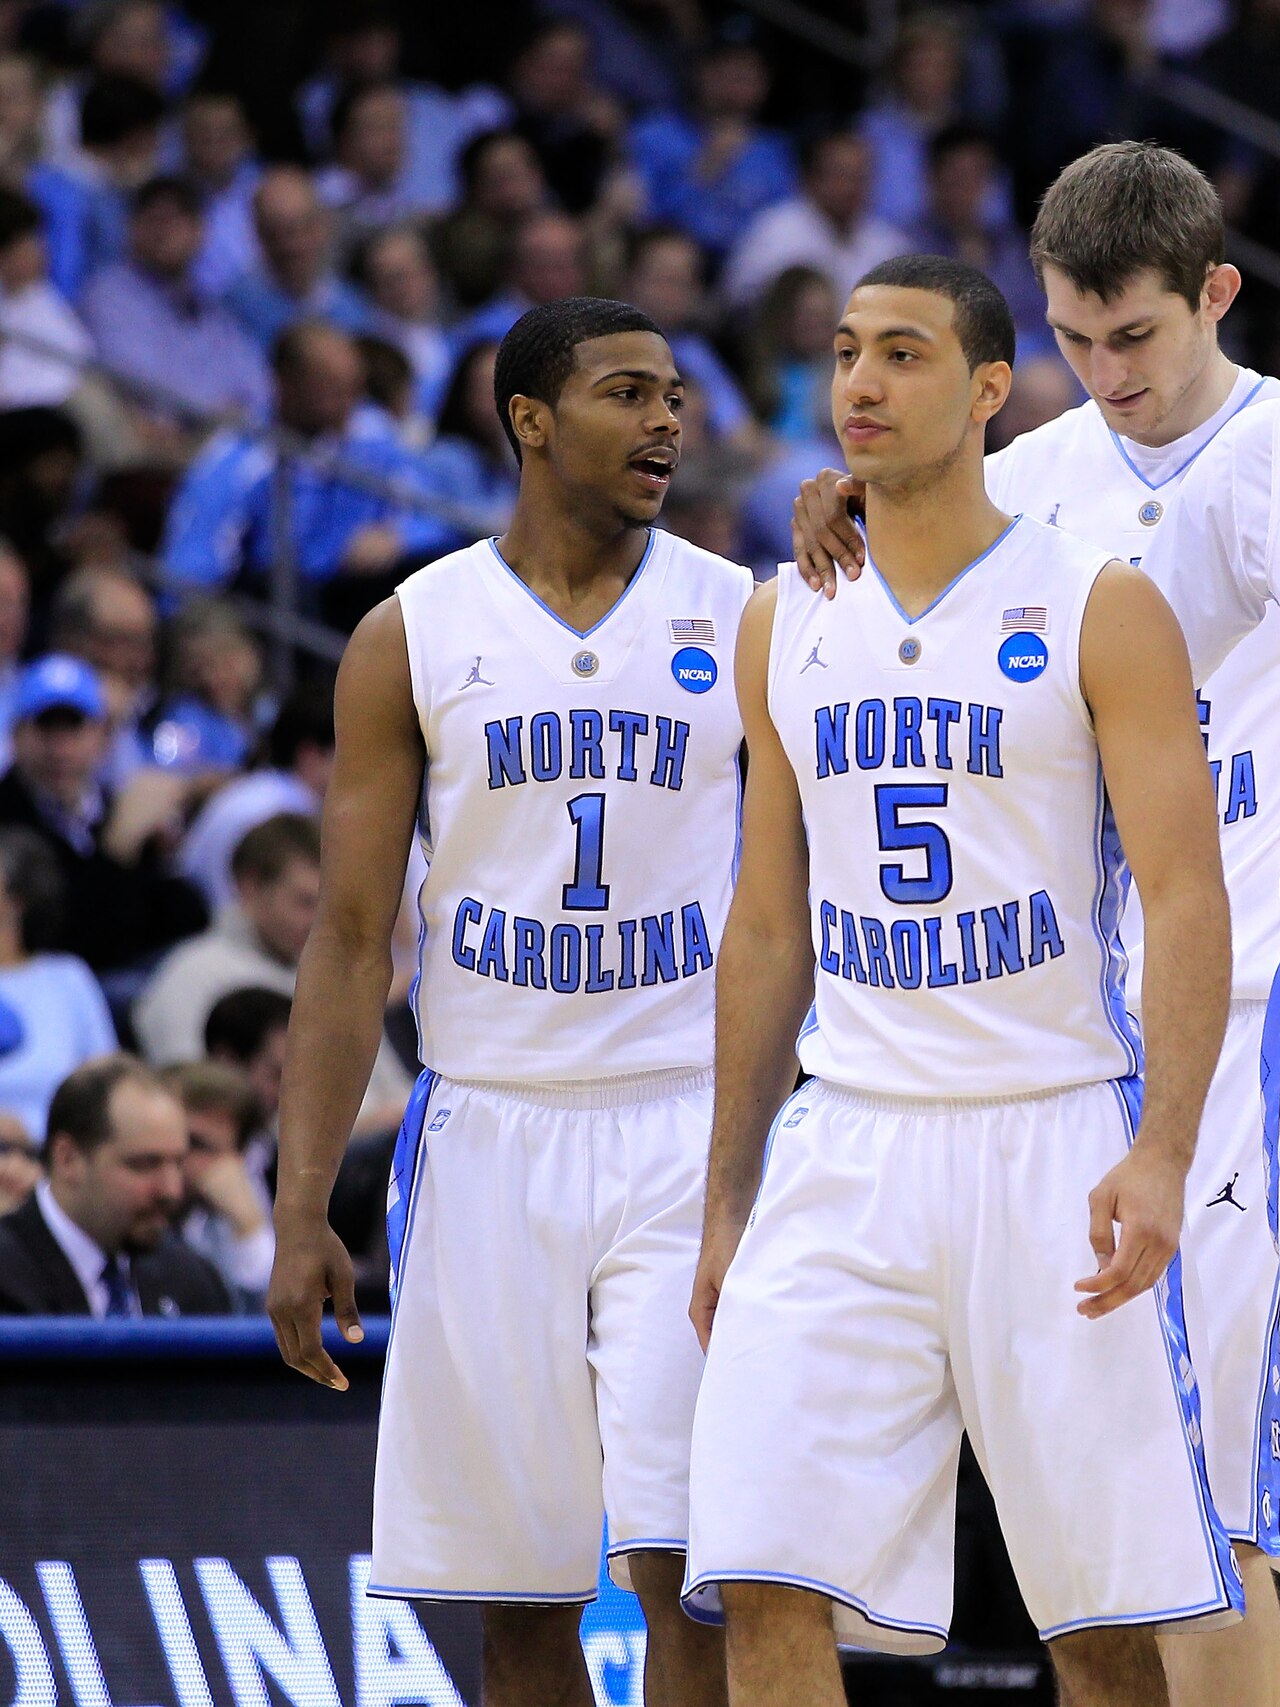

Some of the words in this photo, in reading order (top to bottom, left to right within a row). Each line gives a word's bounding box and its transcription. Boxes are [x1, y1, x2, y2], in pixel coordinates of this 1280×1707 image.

[678, 668, 712, 682] NCAA
[1008, 655, 1045, 669] NCAA
[484, 709, 690, 790] NORTH
[814, 696, 1004, 779] NORTH
[561, 792, 610, 911] 1
[873, 783, 953, 904] 5
[451, 896, 714, 994] CAROLINA
[819, 889, 1065, 990] CAROLINA
